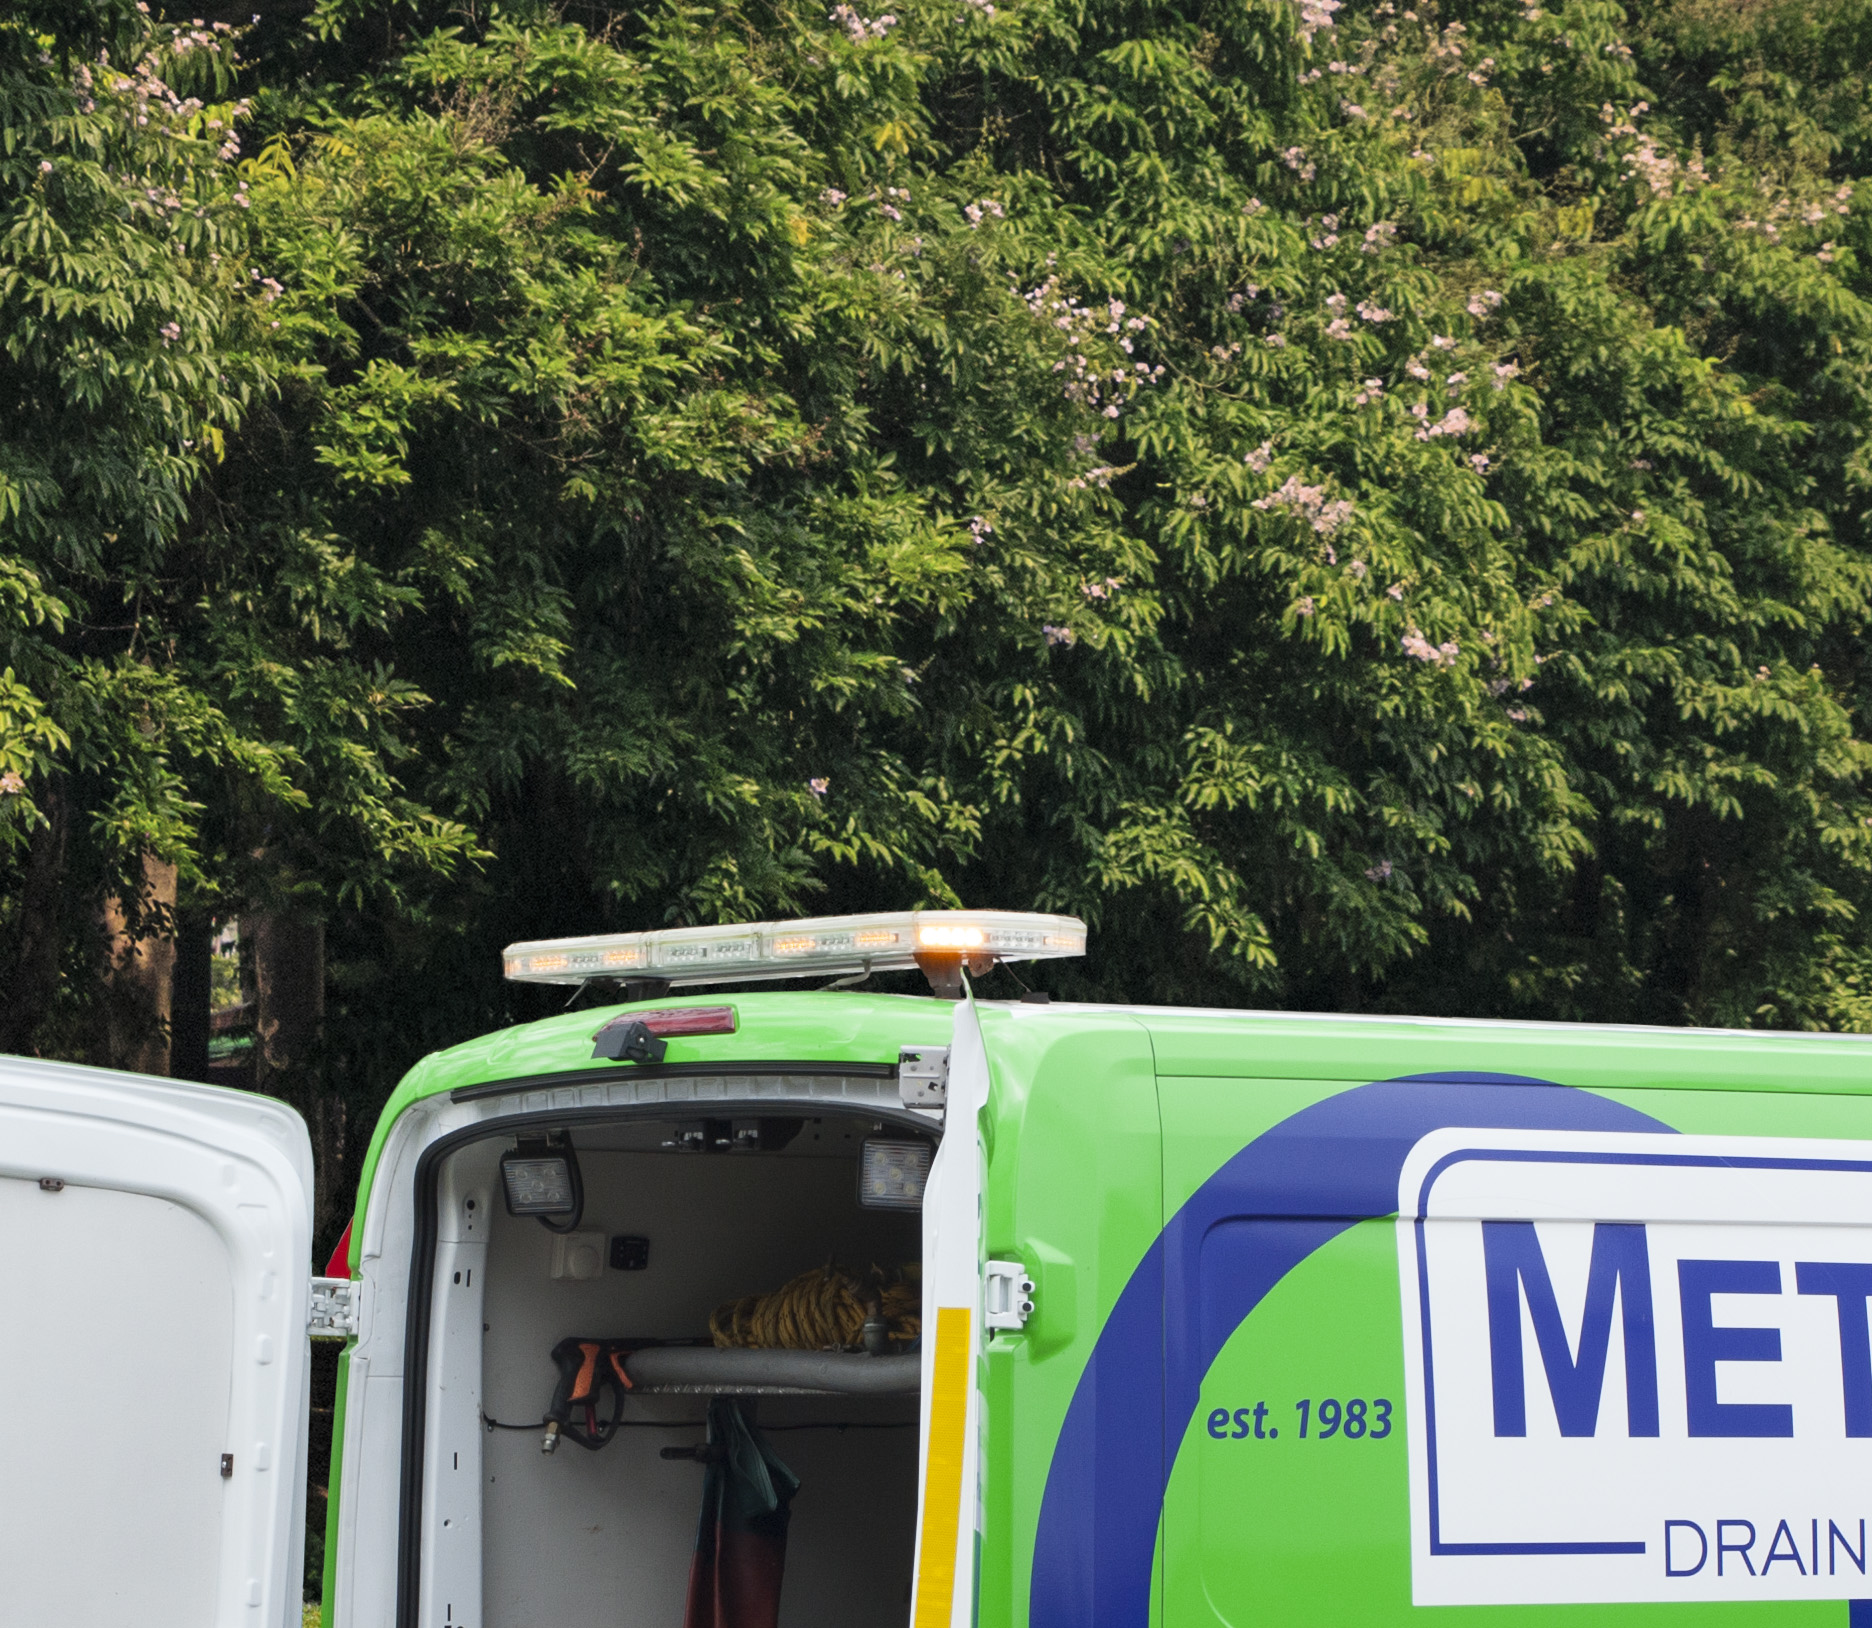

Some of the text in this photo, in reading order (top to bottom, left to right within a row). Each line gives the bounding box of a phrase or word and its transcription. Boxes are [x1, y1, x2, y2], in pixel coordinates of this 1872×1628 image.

[1207, 1398, 1393, 1439] est. 1983
[1663, 1518, 1866, 1577] DRAIN
